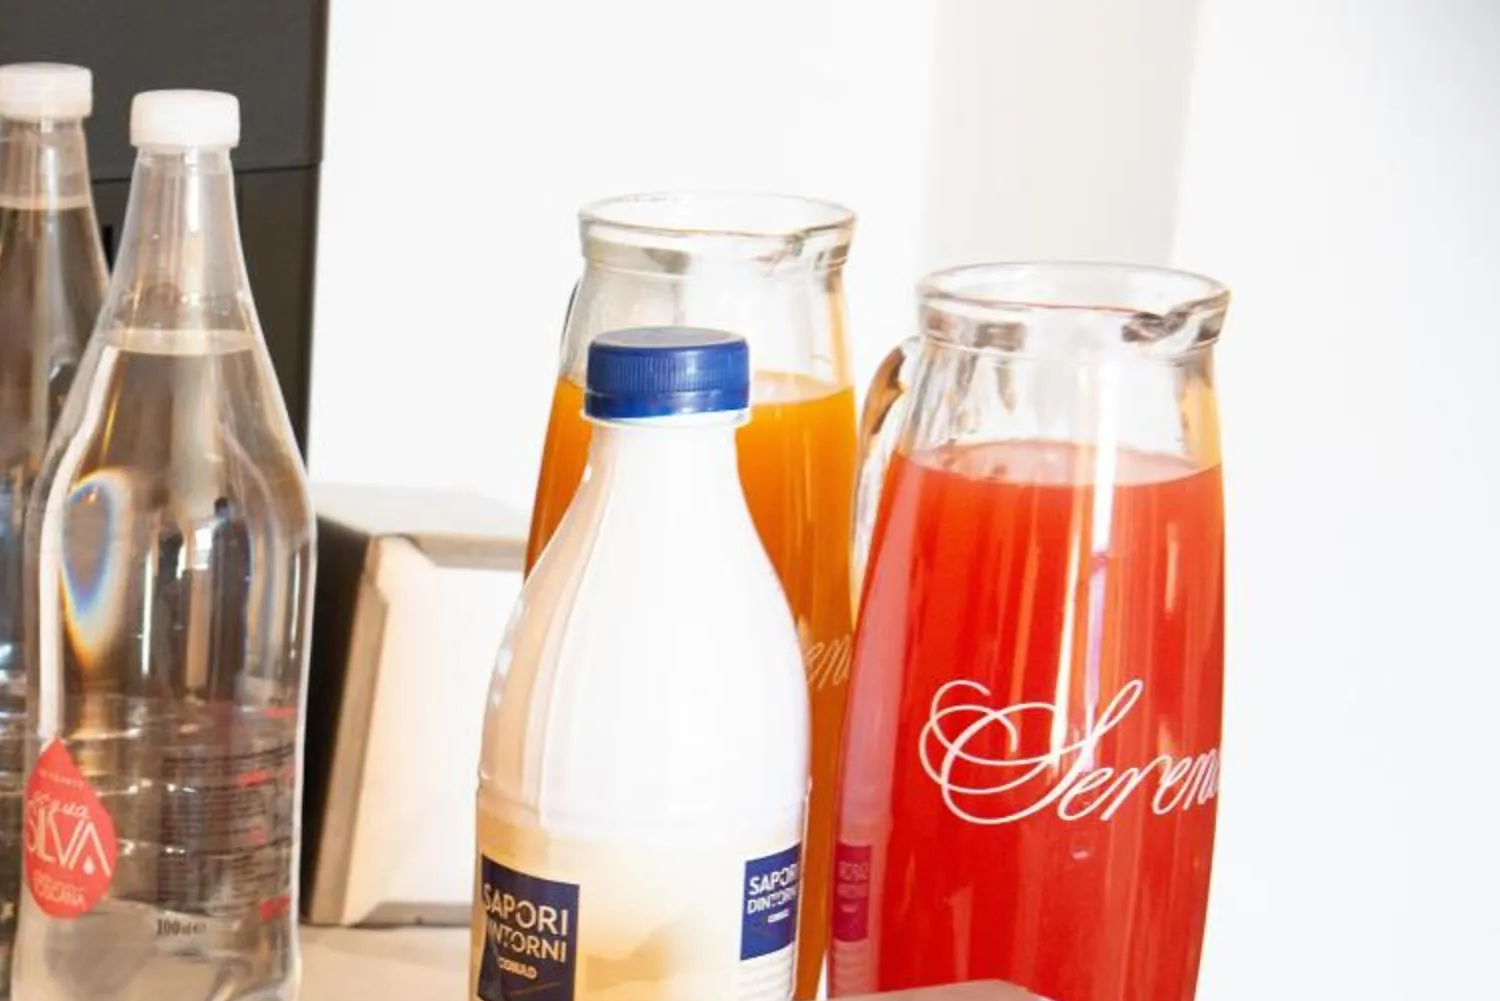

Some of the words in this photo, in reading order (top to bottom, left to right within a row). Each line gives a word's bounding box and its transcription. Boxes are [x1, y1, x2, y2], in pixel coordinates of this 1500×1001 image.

[919, 679, 1220, 824] Seren
[26, 799, 111, 878] SILVA
[483, 883, 569, 937] SAPORI
[748, 863, 799, 896] SAPOR
